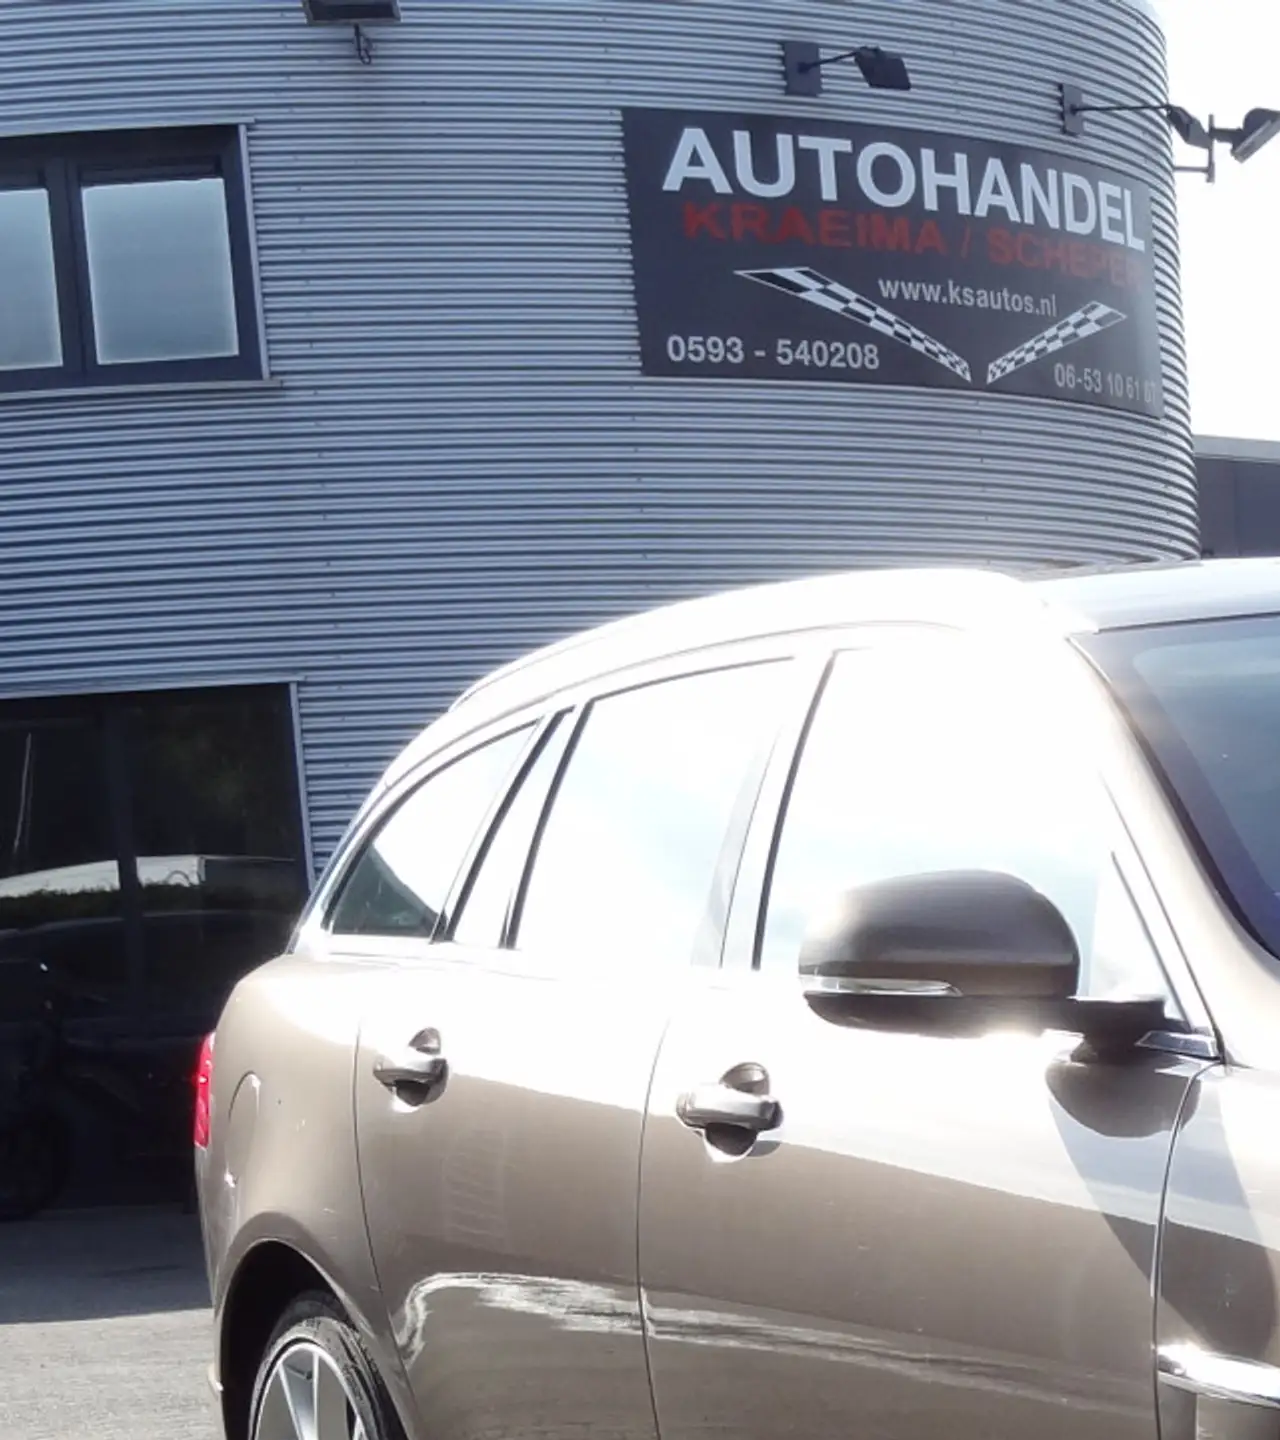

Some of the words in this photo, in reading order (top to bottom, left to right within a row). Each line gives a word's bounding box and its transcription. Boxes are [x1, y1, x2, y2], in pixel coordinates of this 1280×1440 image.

[662, 127, 1146, 252] AUTOHANDEL
[684, 201, 949, 257] KRAEIMA
[878, 271, 1058, 317] www.ksautos.nl
[667, 334, 745, 364] 0593
[776, 339, 879, 369] 540208
[1054, 362, 1102, 393] 06-53
[1108, 372, 1123, 398] 10
